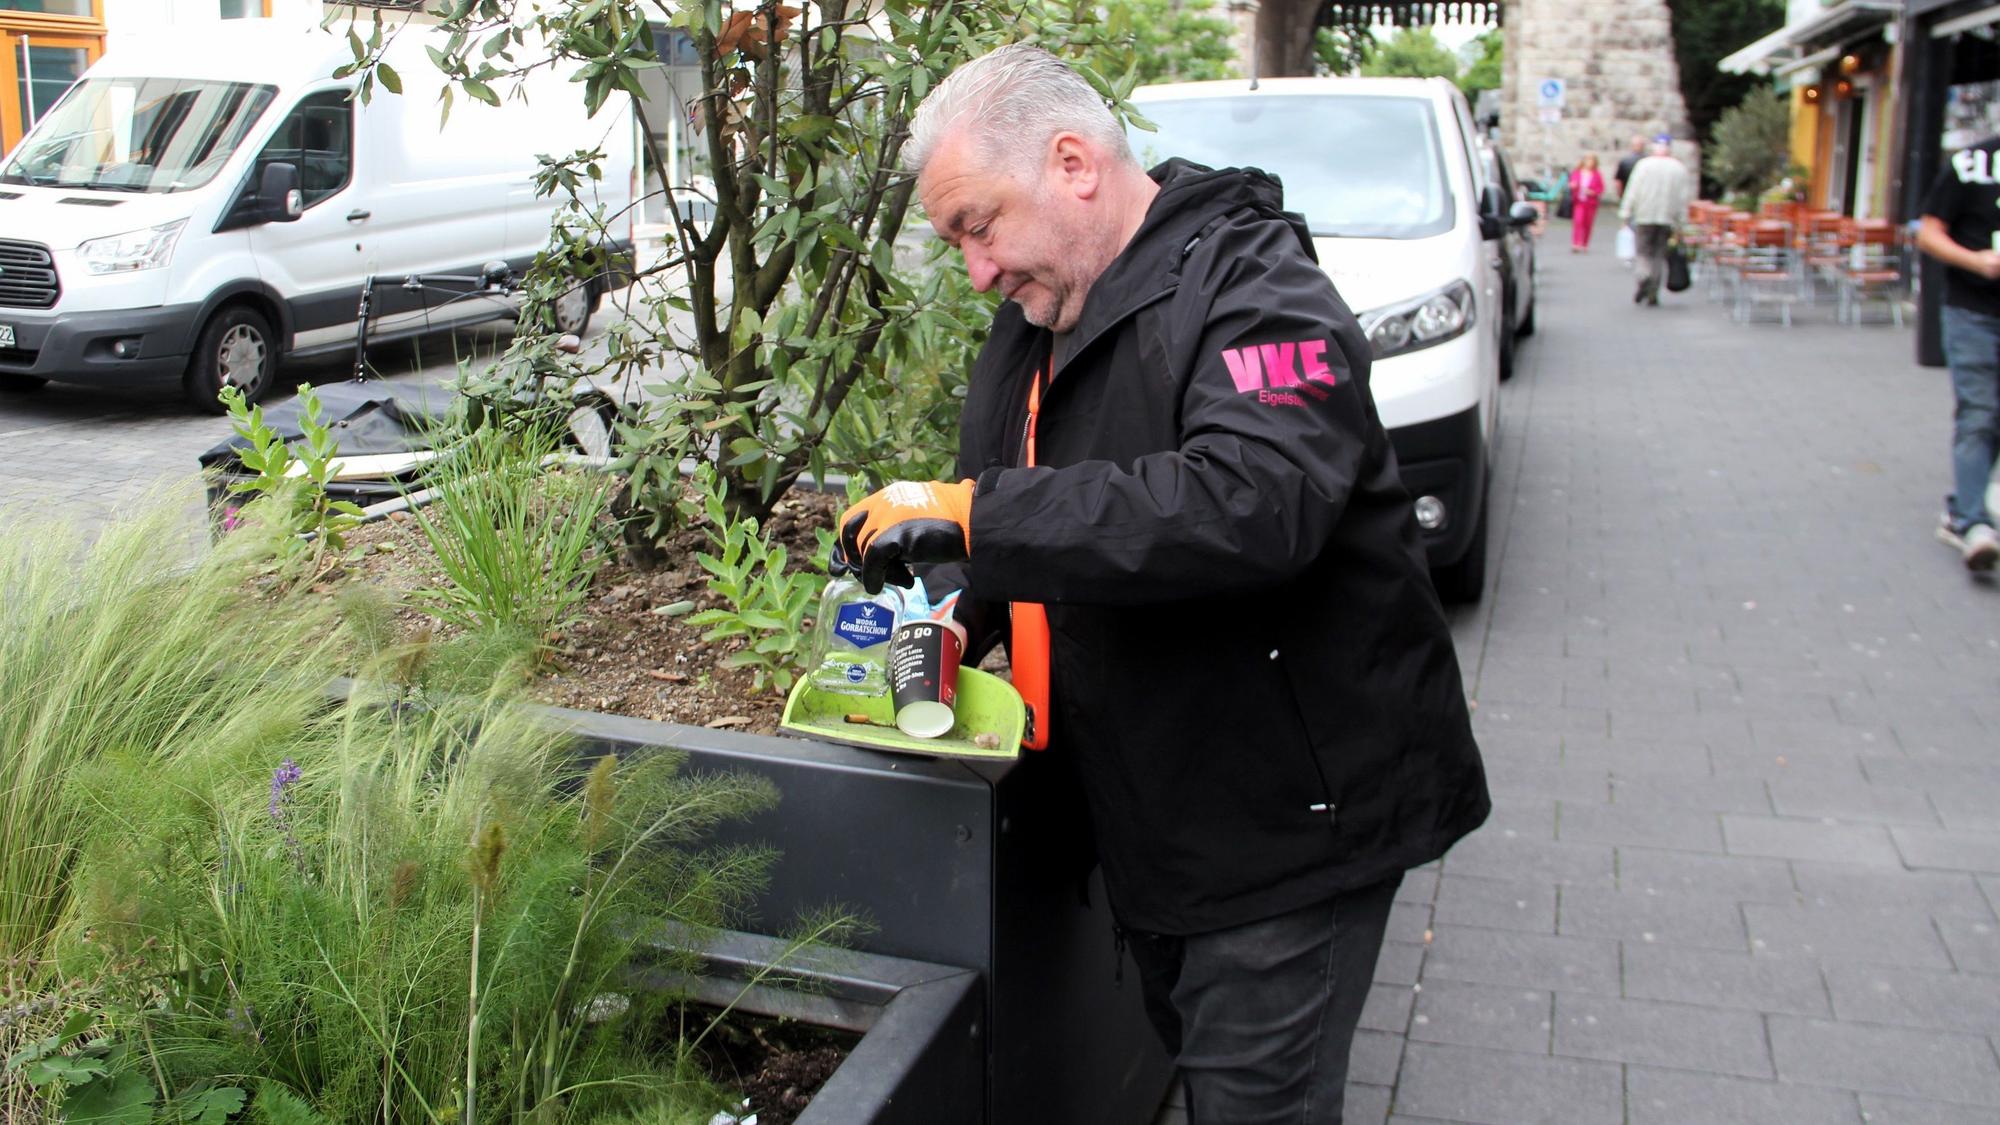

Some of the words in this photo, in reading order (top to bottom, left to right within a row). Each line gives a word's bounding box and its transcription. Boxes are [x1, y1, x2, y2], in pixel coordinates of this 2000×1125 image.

[1221, 339, 1336, 394] VKE
[840, 621, 888, 635] GORBATSCHOW
[855, 618, 877, 627] WODKA
[914, 627, 932, 639] go
